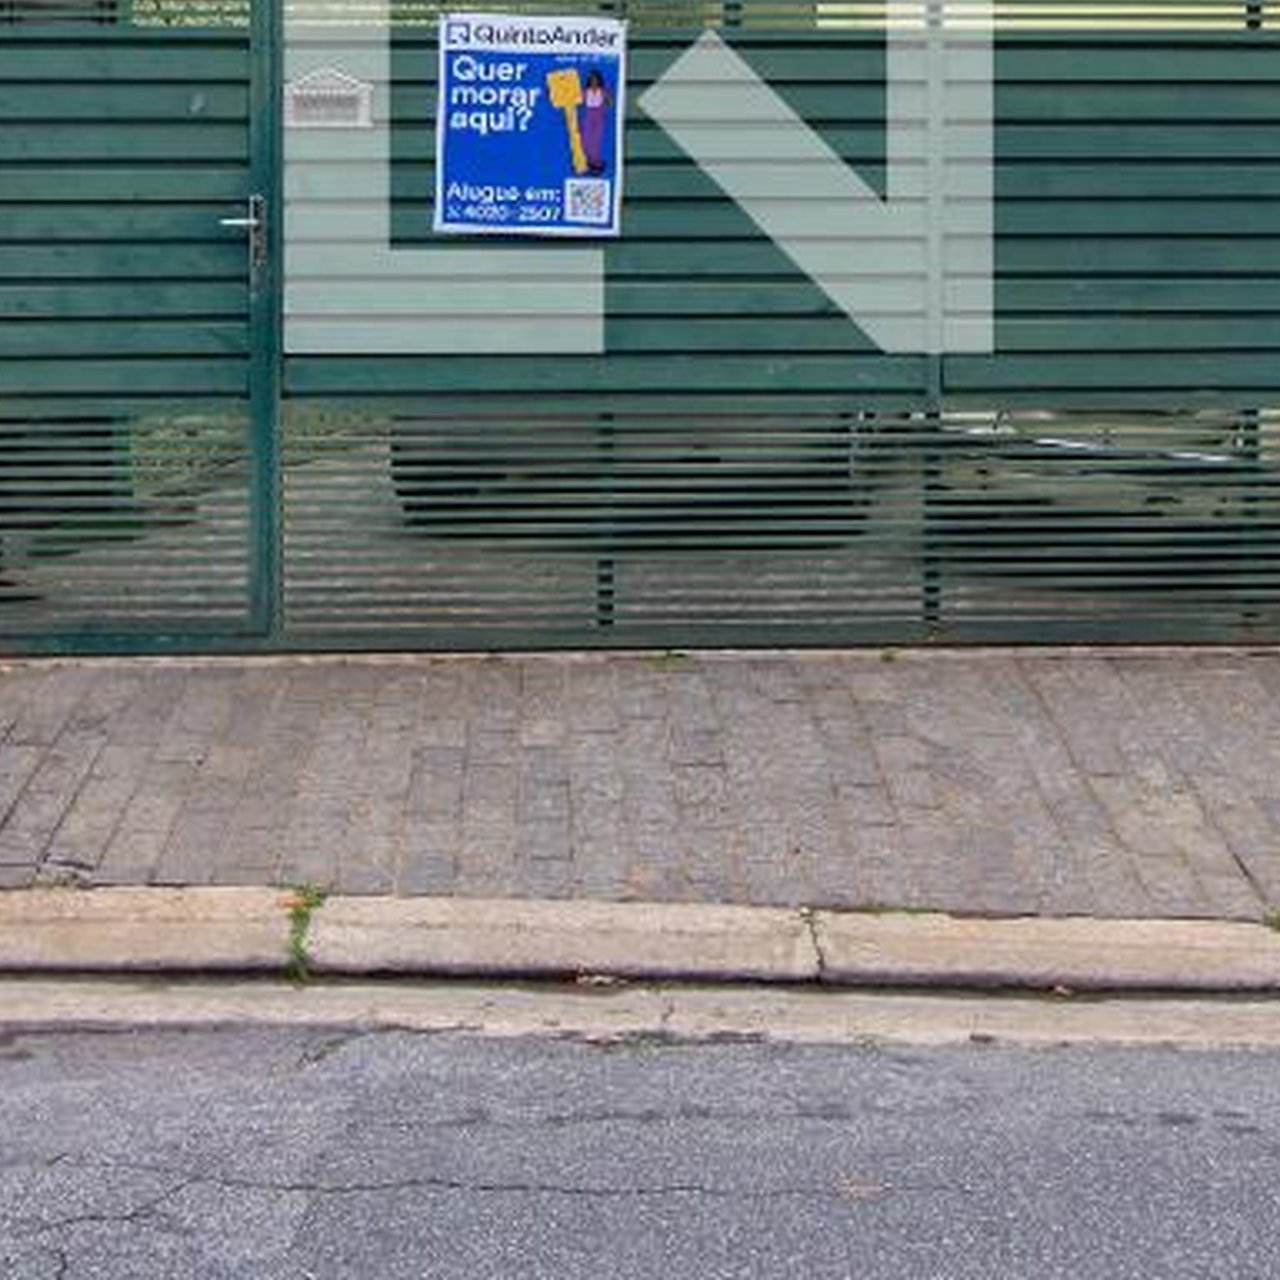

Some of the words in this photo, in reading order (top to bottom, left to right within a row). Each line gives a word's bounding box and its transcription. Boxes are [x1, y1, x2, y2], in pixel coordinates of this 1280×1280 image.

[474, 25, 619, 47] QuintoAndar
[452, 55, 528, 81] Quer
[451, 86, 541, 108] morar
[450, 105, 534, 135] aqui?
[447, 182, 521, 204] Alugue
